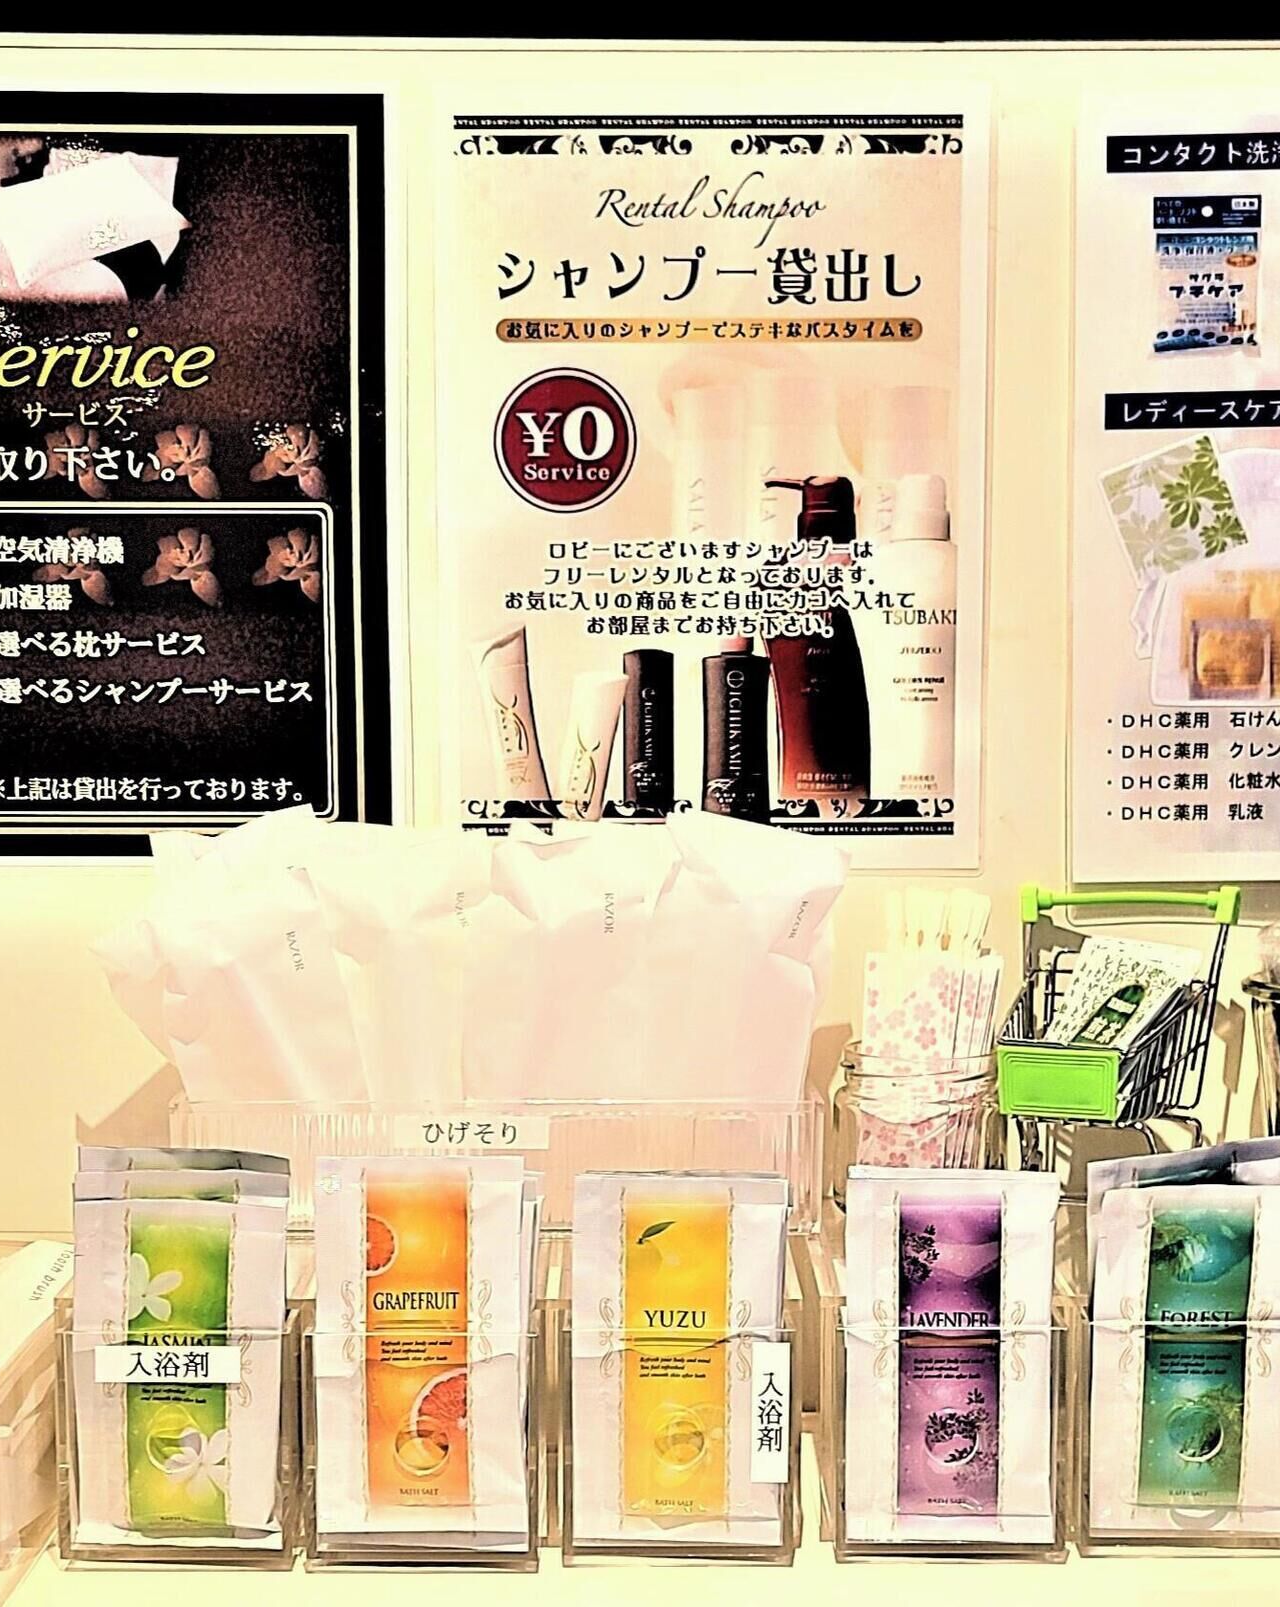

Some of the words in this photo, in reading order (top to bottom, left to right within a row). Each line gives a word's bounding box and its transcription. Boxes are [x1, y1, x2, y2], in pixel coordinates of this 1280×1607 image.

[595, 176, 709, 227] Rental
[702, 171, 827, 249] Shampoo
[496, 245, 923, 305] シャンプー貸出し
[506, 320, 915, 341] お気に入りのシャンプーでステキなバスタイムを
[22, 402, 128, 427] サービス
[523, 464, 610, 482] Service
[548, 541, 874, 561] ロビーにございますシャンプーは
[505, 591, 916, 611] お気に入りの商品をご自由にカゴへ入れて
[1229, 802, 1264, 822] 乳液
[421, 1121, 519, 1146] ひげそり
[372, 1291, 460, 1312] GRAPEFRUIT
[643, 1309, 707, 1329] YUZU
[910, 1311, 990, 1328] LAVENDER
[1161, 1310, 1233, 1328] FOREST
[125, 1351, 210, 1378] 入浴剤
[756, 1371, 783, 1453] 入浴剤
